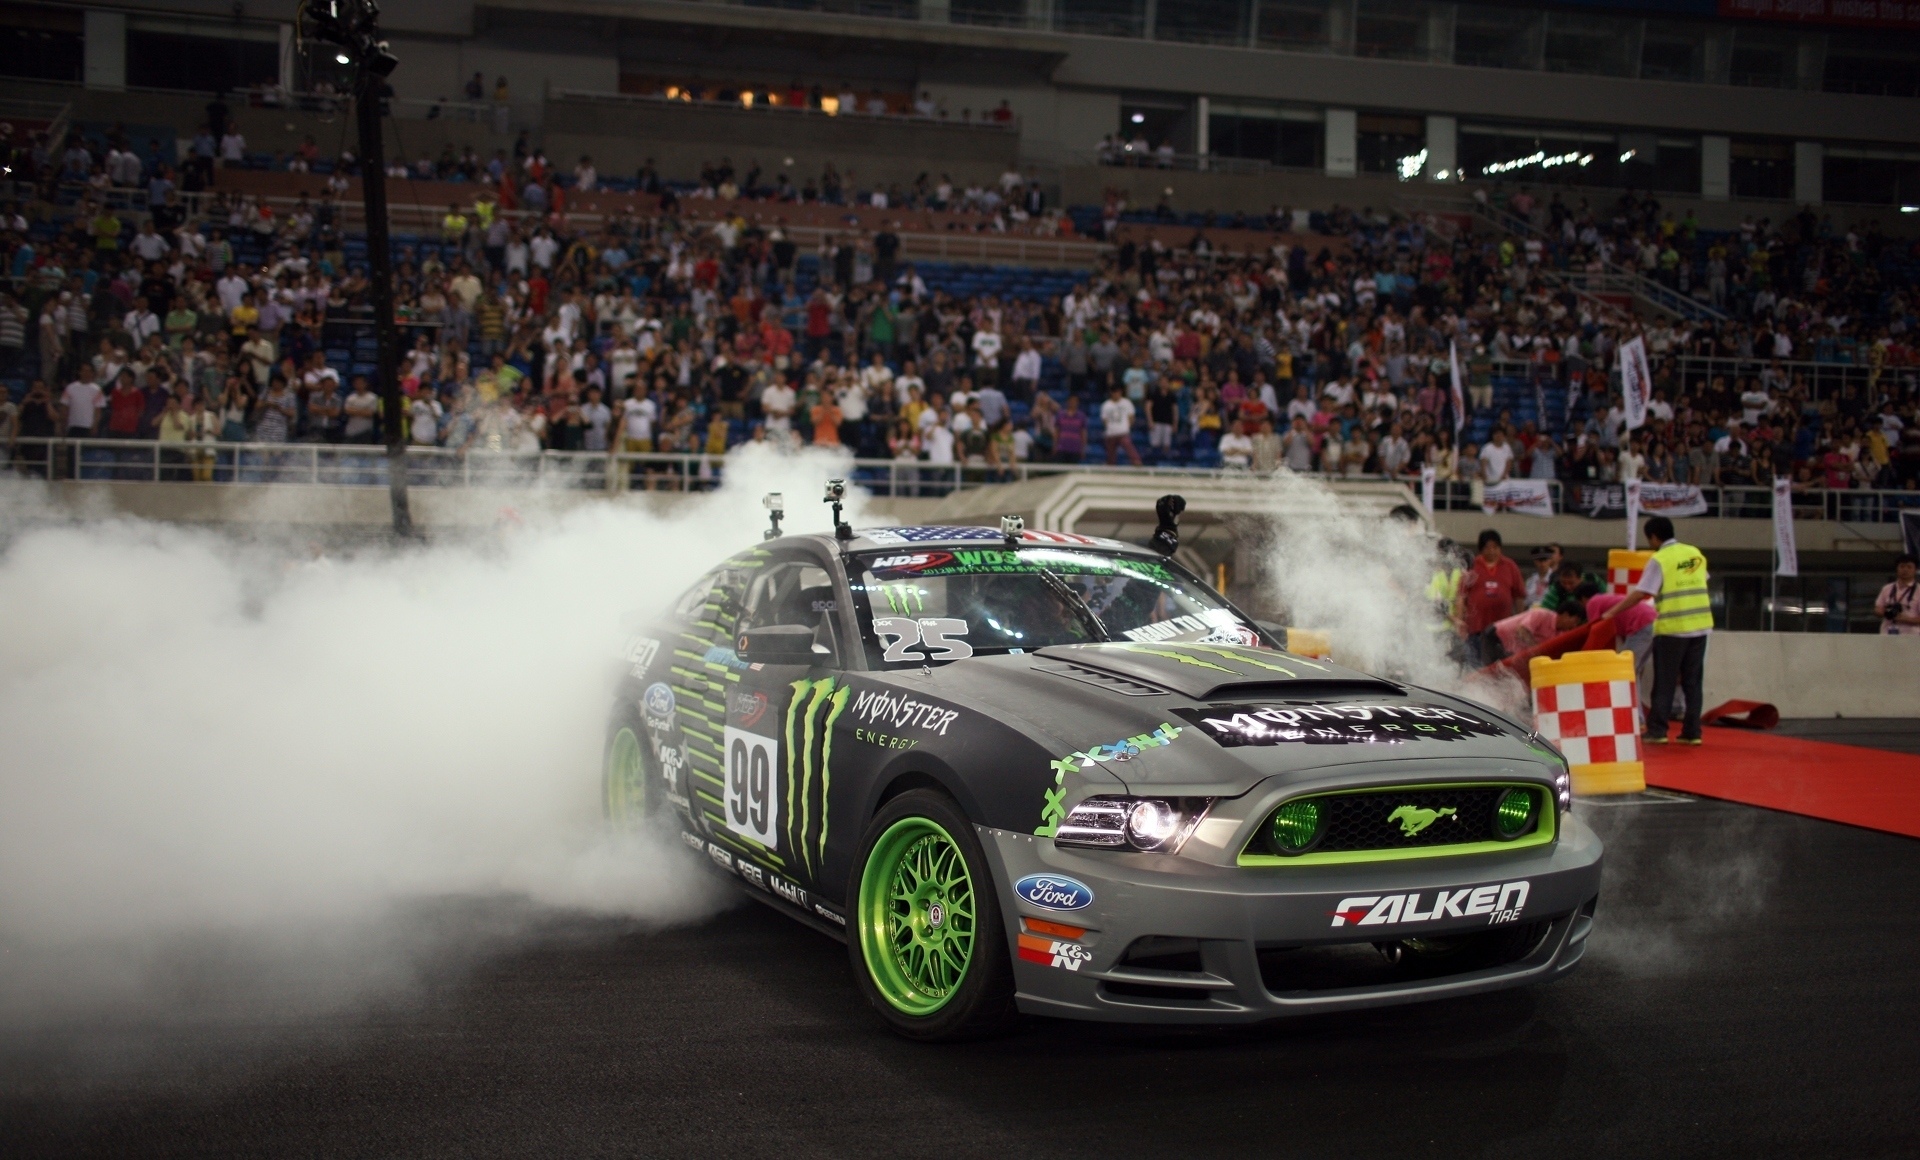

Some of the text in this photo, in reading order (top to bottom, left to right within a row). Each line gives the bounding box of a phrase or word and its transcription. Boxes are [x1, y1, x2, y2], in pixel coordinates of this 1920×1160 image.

[872, 554, 930, 569] WDS
[953, 550, 1022, 566] WDS
[872, 617, 973, 662] 25
[1122, 619, 1185, 642] READY
[1174, 614, 1207, 633] TO
[856, 728, 919, 750] ENERGY
[731, 737, 770, 836] 99
[1029, 878, 1078, 906] Ford
[1330, 880, 1530, 927] FALKEN
[1487, 906, 1524, 926] TIRE
